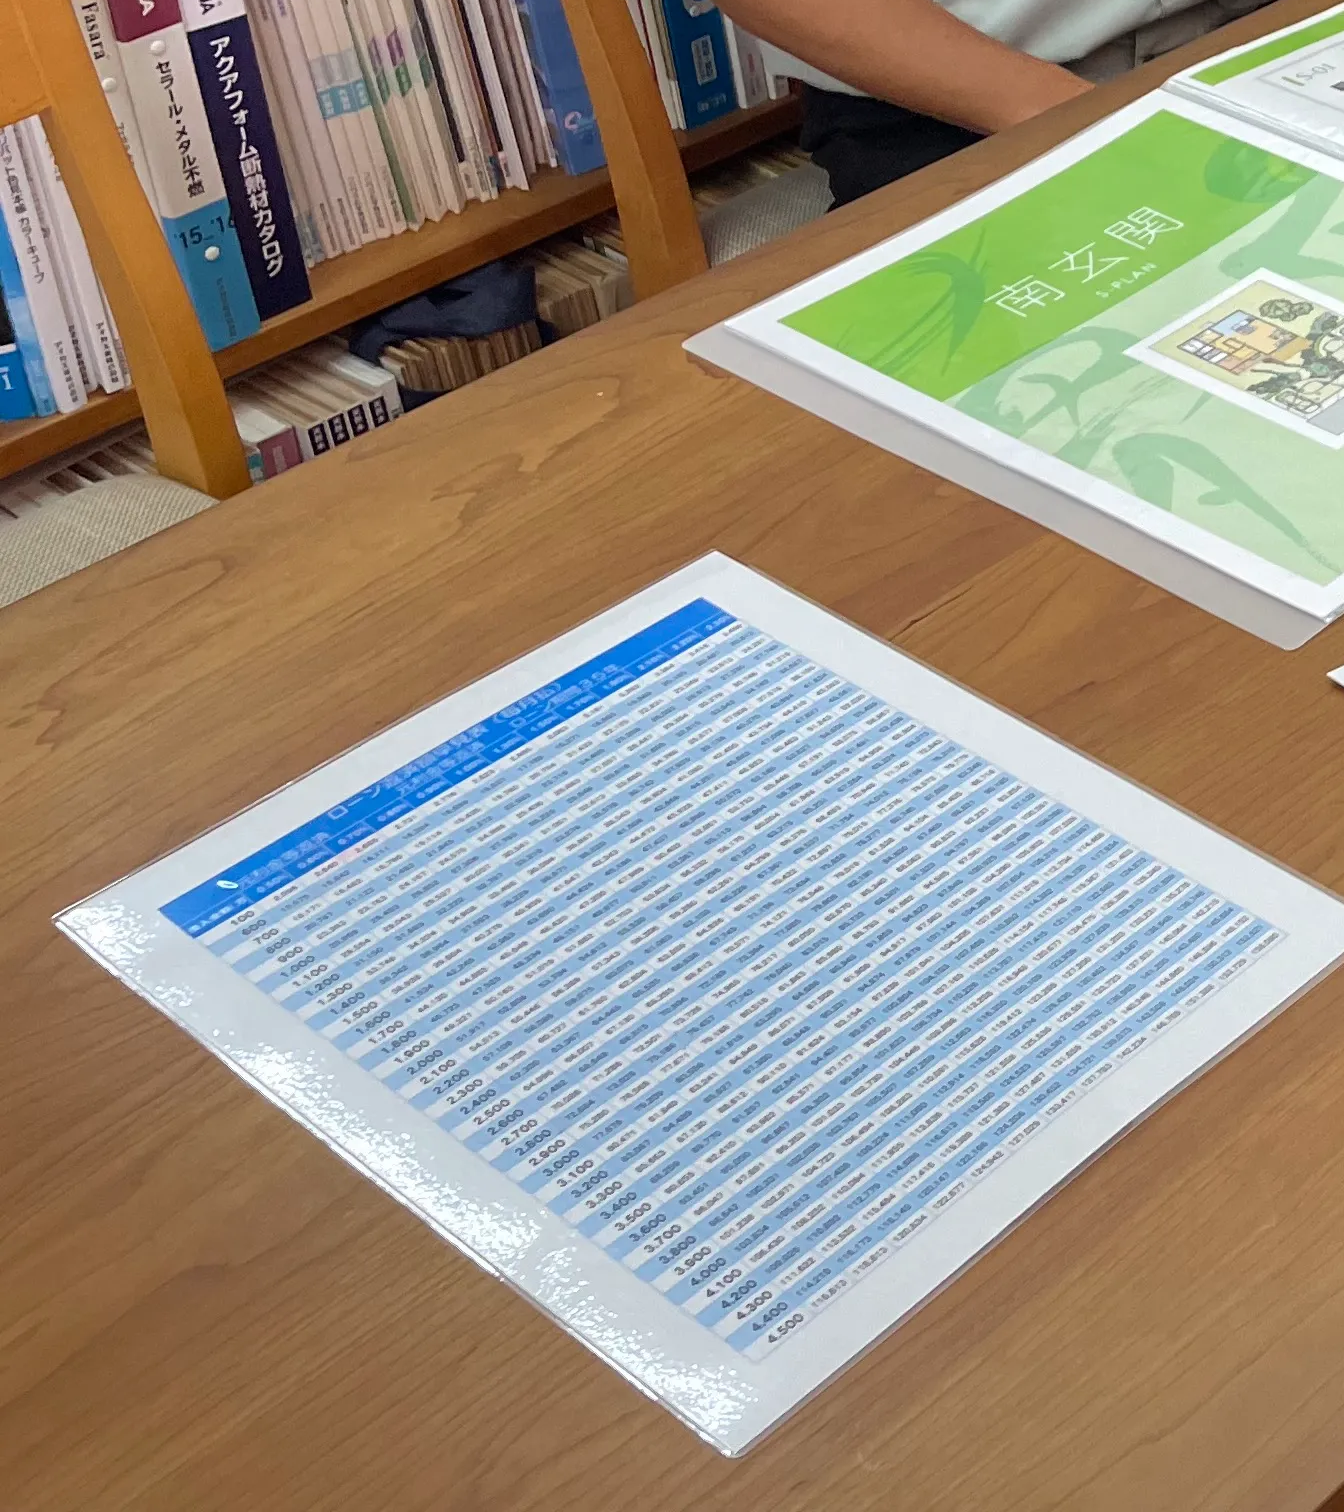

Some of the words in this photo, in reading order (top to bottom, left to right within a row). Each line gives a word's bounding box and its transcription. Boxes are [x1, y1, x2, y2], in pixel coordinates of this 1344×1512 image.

[81, 1, 110, 62] Fasara
[209, 34, 284, 278] アクアフォーム断熱材カタログ
[984, 206, 1184, 318] 南玄関
[227, 909, 256, 927] 100
[239, 918, 268, 936] 600
[251, 927, 280, 945] 700
[264, 936, 293, 954] 800
[276, 945, 305, 963] 900
